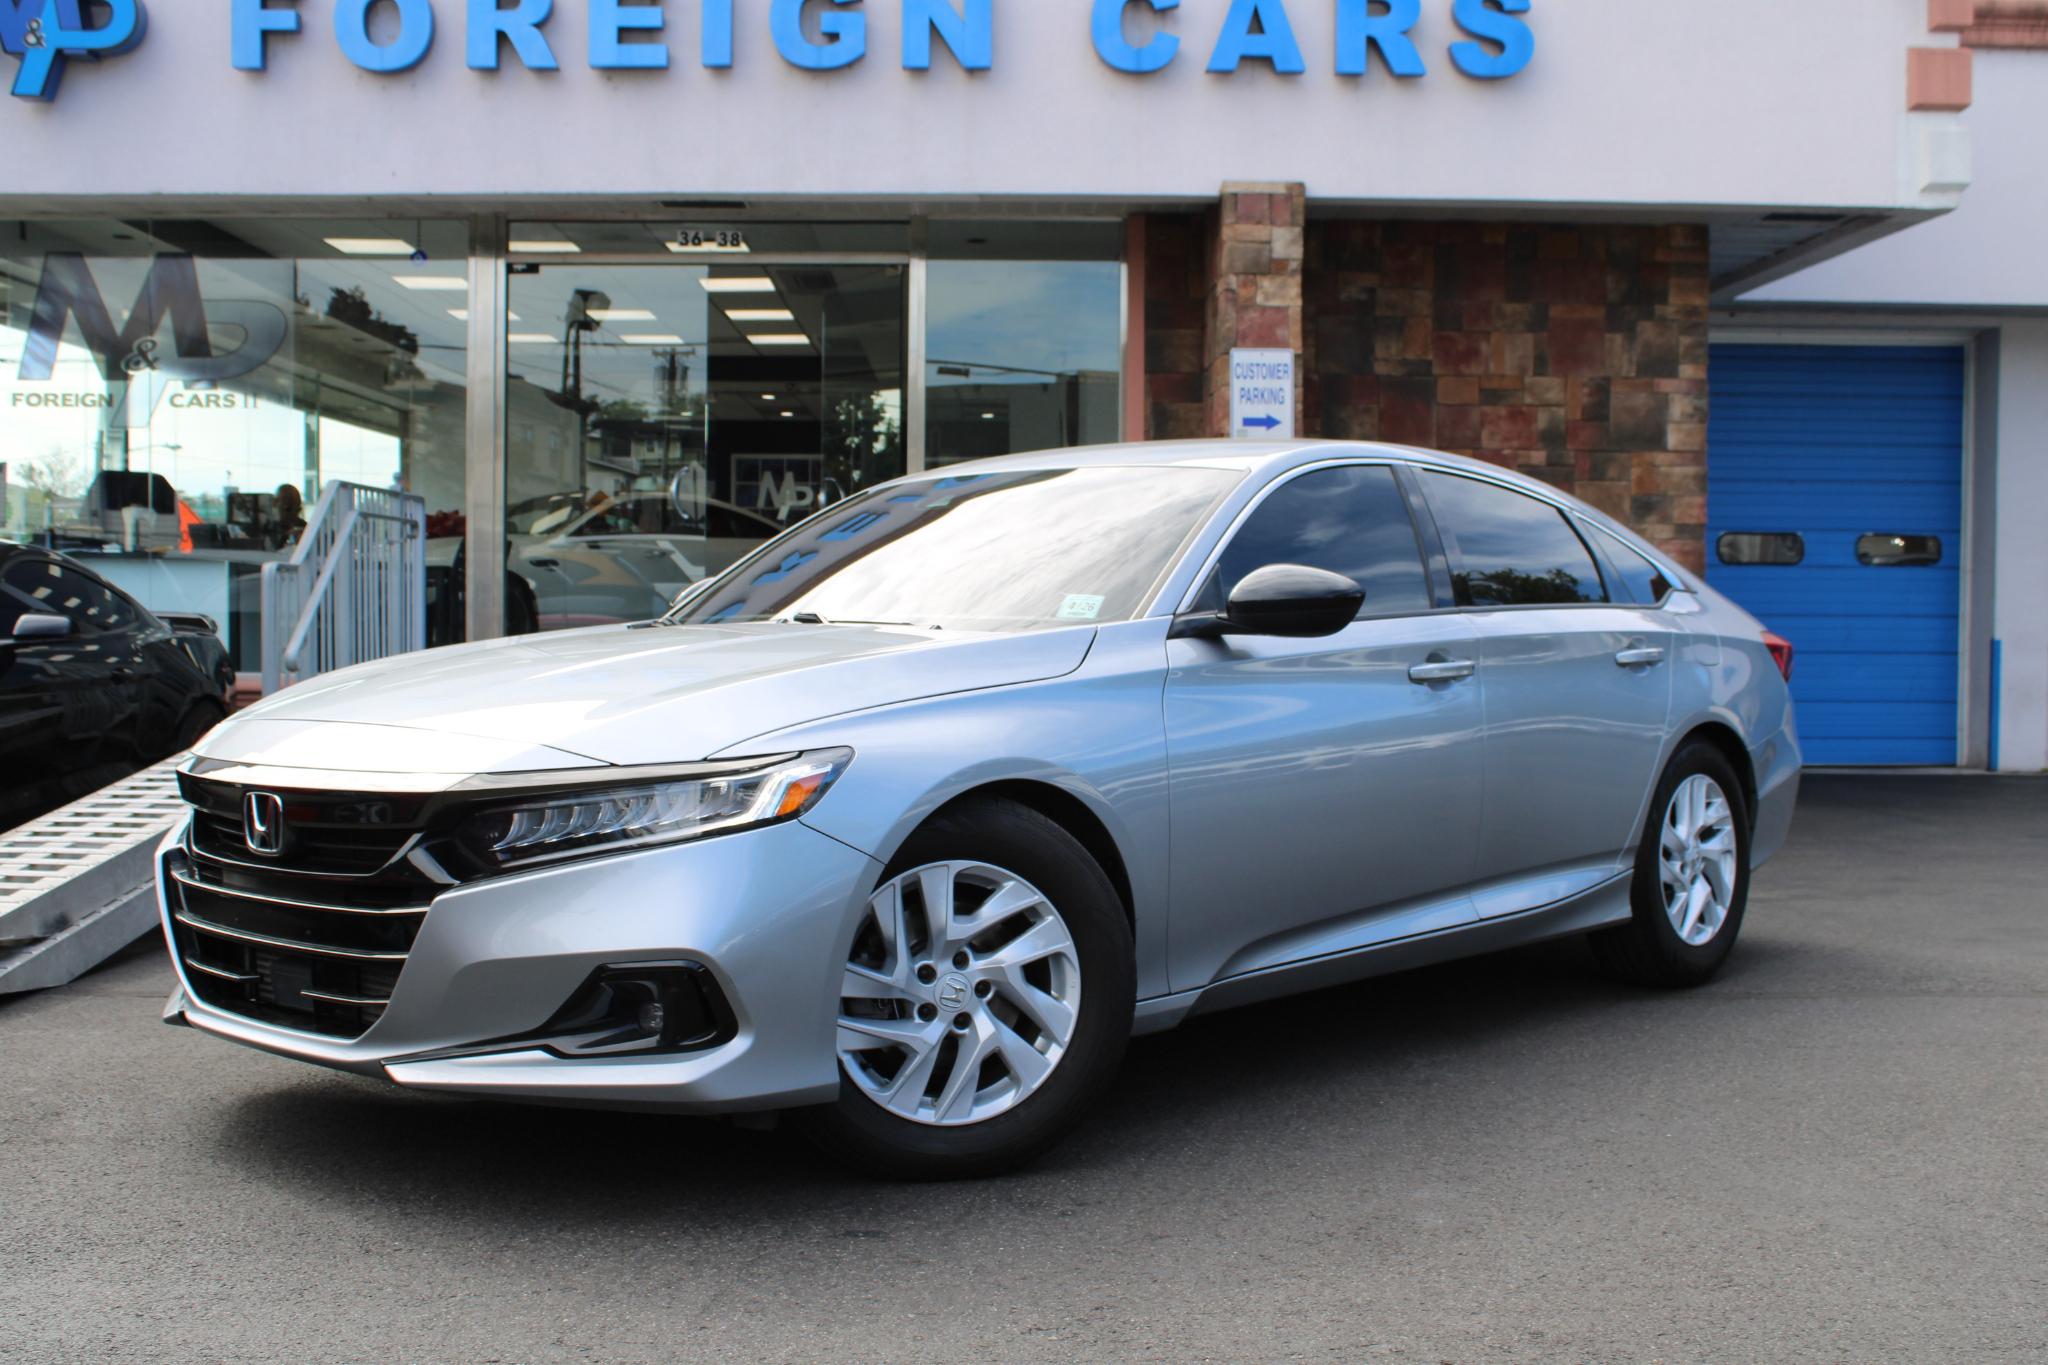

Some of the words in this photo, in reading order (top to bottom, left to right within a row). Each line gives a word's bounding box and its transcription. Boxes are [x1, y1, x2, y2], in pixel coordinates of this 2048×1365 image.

[231, 0, 993, 72] FOREIGN
[1090, 0, 1535, 78] CARS
[1235, 363, 1289, 380] CUSTOMER
[12, 393, 114, 408] FOREIGN
[169, 393, 236, 408] CARS
[1240, 387, 1285, 405] PARKING
